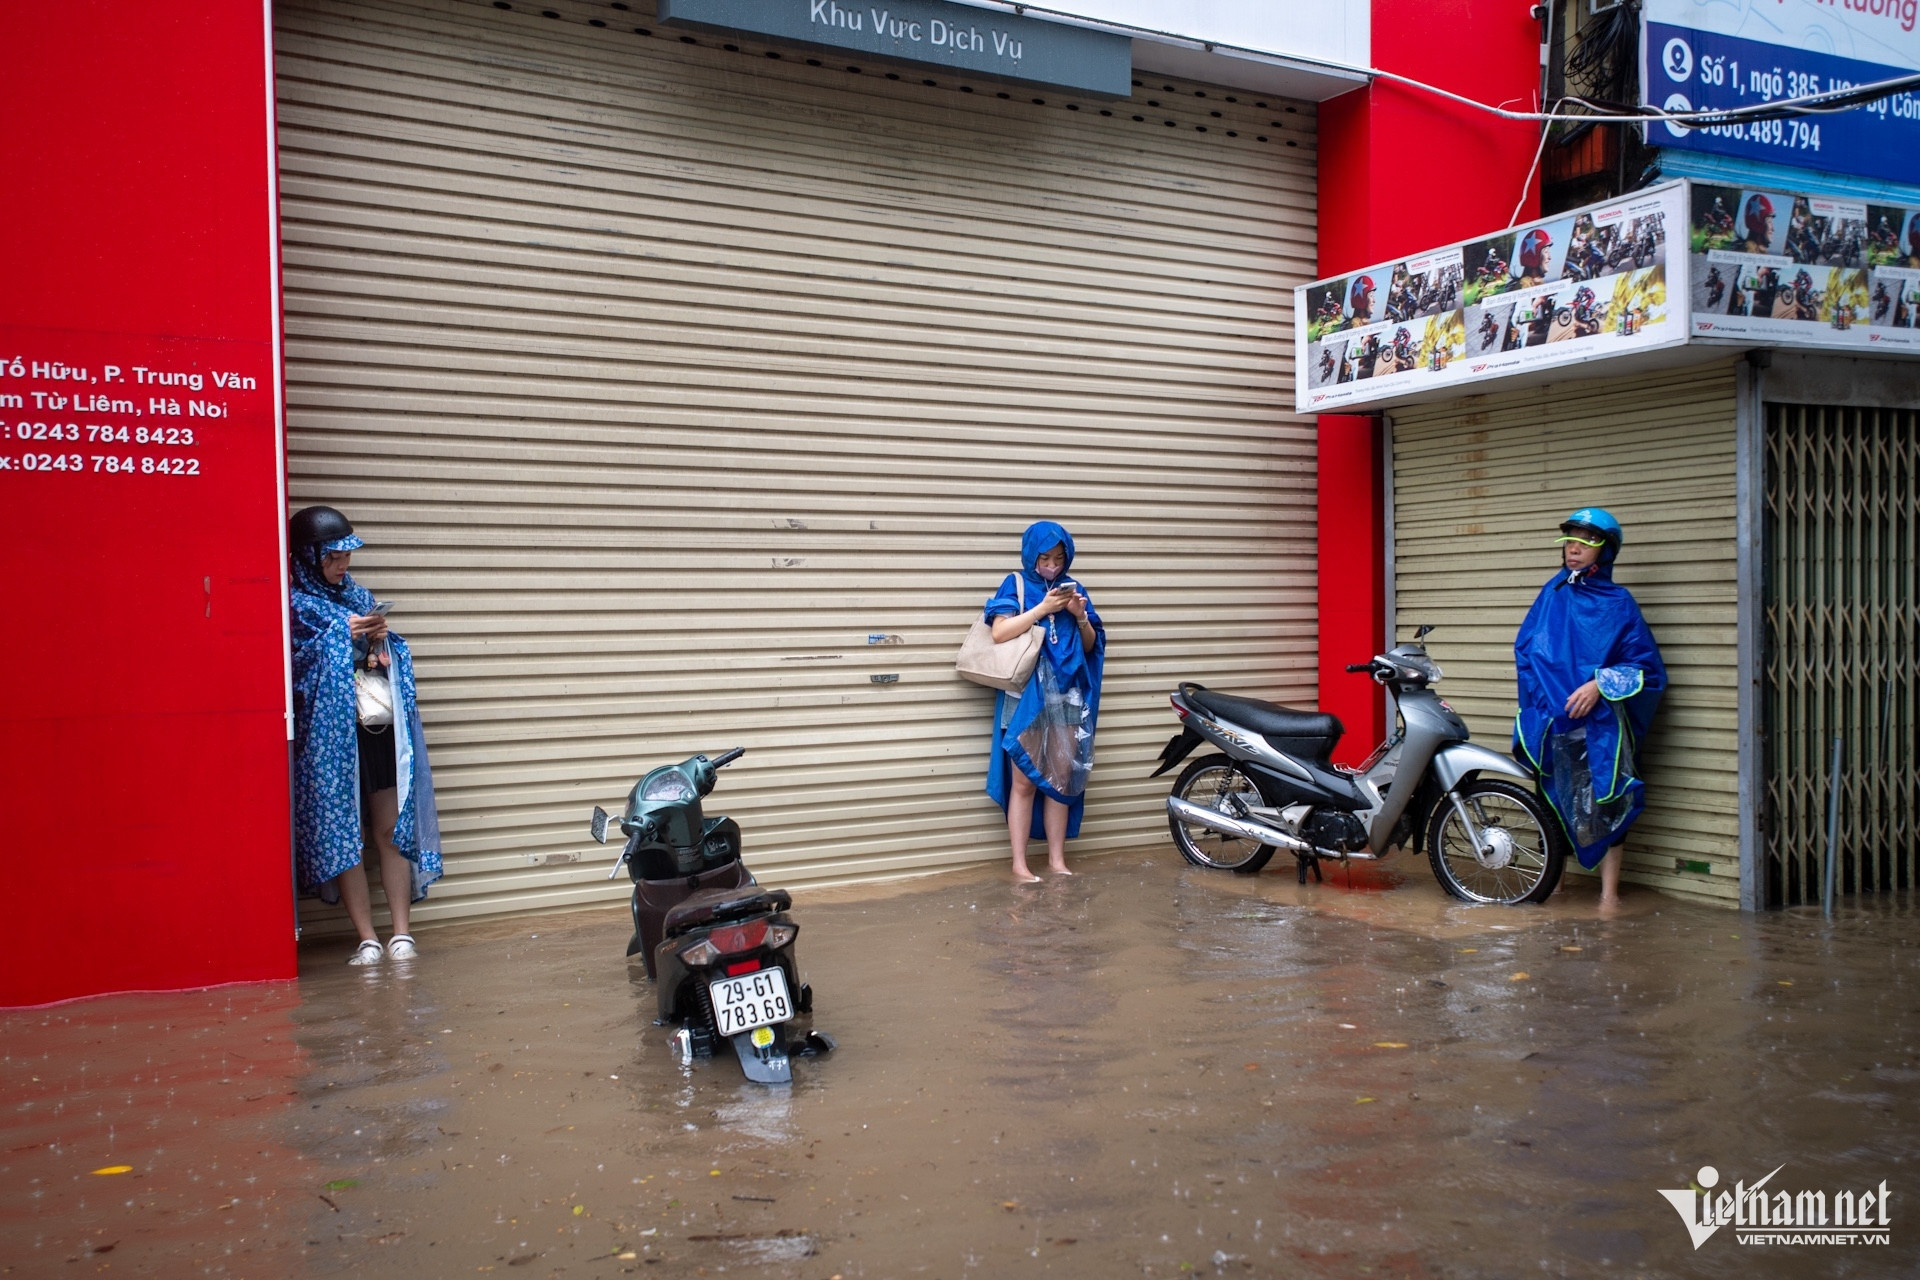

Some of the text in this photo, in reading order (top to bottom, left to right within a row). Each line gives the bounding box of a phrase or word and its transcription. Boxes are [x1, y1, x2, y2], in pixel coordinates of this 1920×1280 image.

[810, 0, 1023, 65] Khu Vực Dịch Vụ
[1700, 55, 1726, 87] Số
[1729, 61, 1745, 96] 1,
[1750, 66, 1783, 101] ngõ
[104, 365, 125, 383] P.
[132, 366, 203, 391] Trung
[211, 371, 257, 390] Văn
[31, 391, 68, 410] Từ
[73, 394, 142, 417] Liêm,
[149, 397, 181, 416] Hà
[17, 422, 80, 441] 0243
[86, 424, 130, 443] 784
[135, 426, 194, 445] 8423
[91, 455, 135, 473] 784
[141, 457, 200, 476] 8422
[722, 973, 775, 1005] 29-G1
[721, 996, 788, 1032] 783.69
